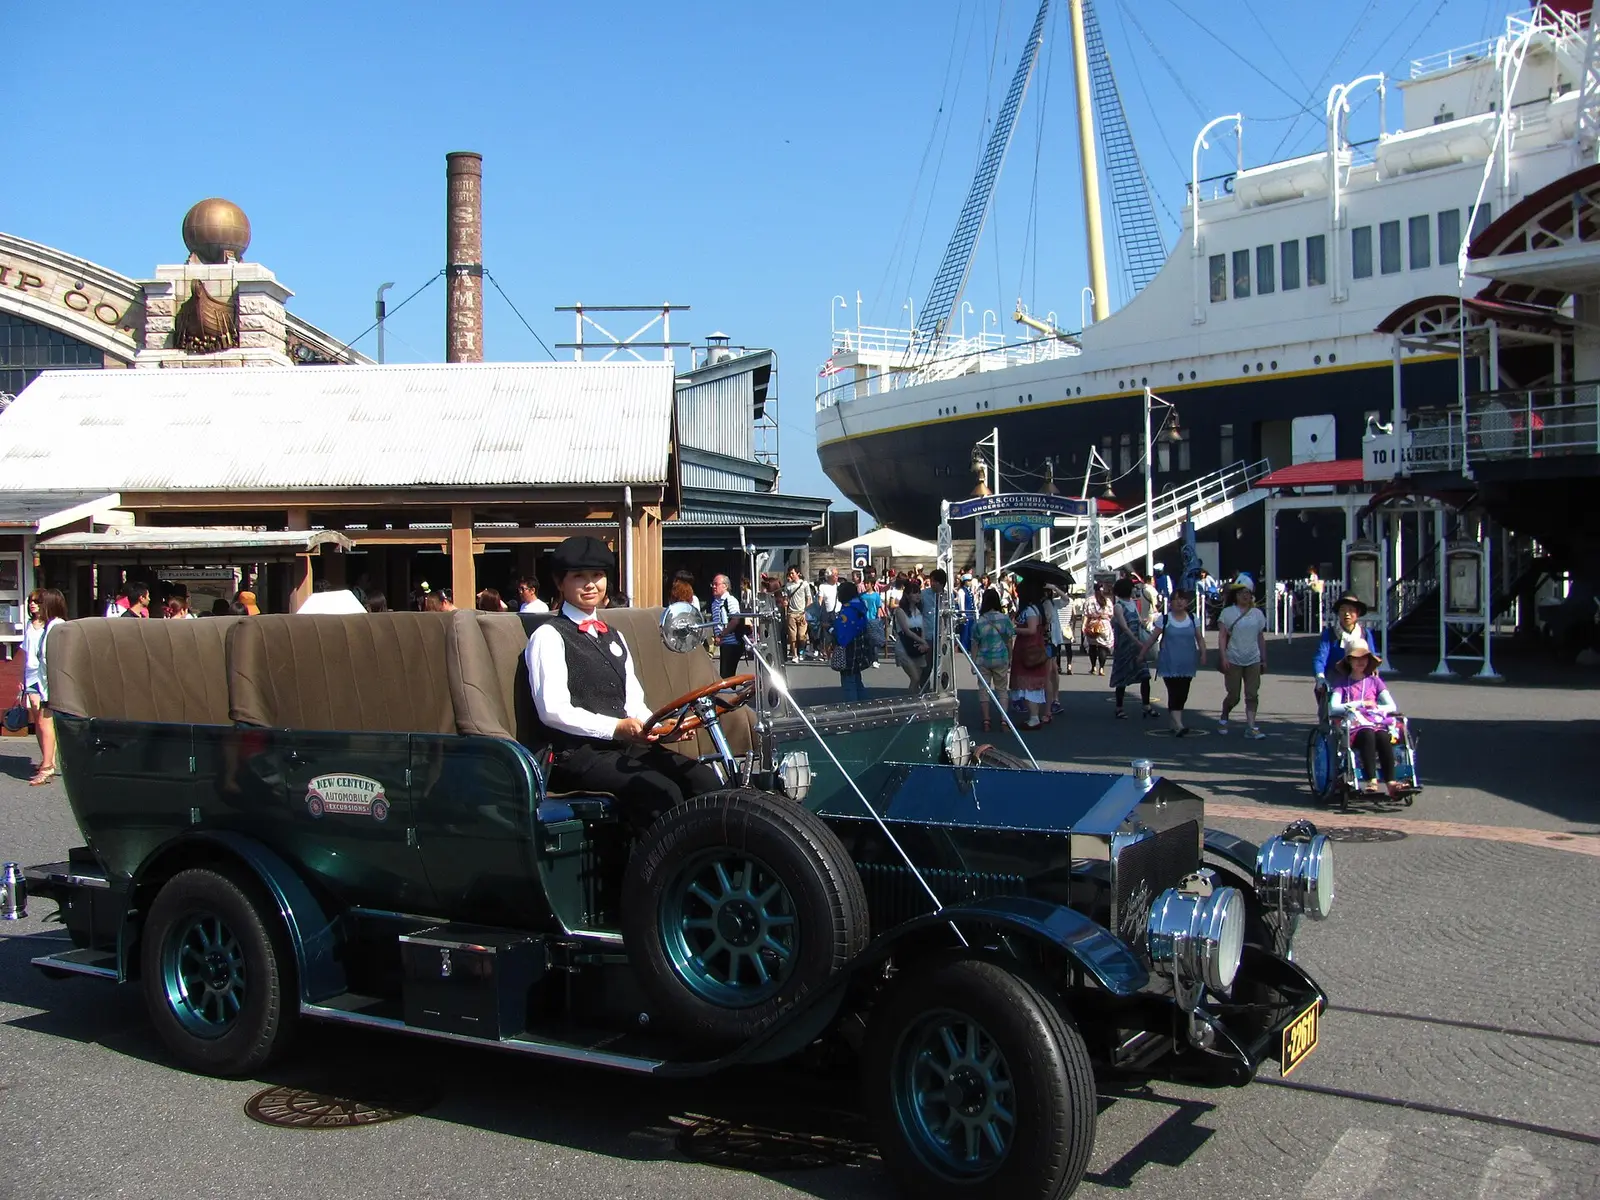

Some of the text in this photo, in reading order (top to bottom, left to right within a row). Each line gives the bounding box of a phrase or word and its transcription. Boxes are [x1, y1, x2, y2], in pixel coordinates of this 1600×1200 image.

[1373, 449, 1387, 465] TO
[1003, 496, 1047, 504] COLUMBIA
[972, 502, 1064, 512] UNDERSEA OBSERVATORY
[316, 777, 376, 793] NEW CENTURY
[325, 791, 369, 803] AUTOMOBILE
[328, 803, 368, 812] EXCURSIONS
